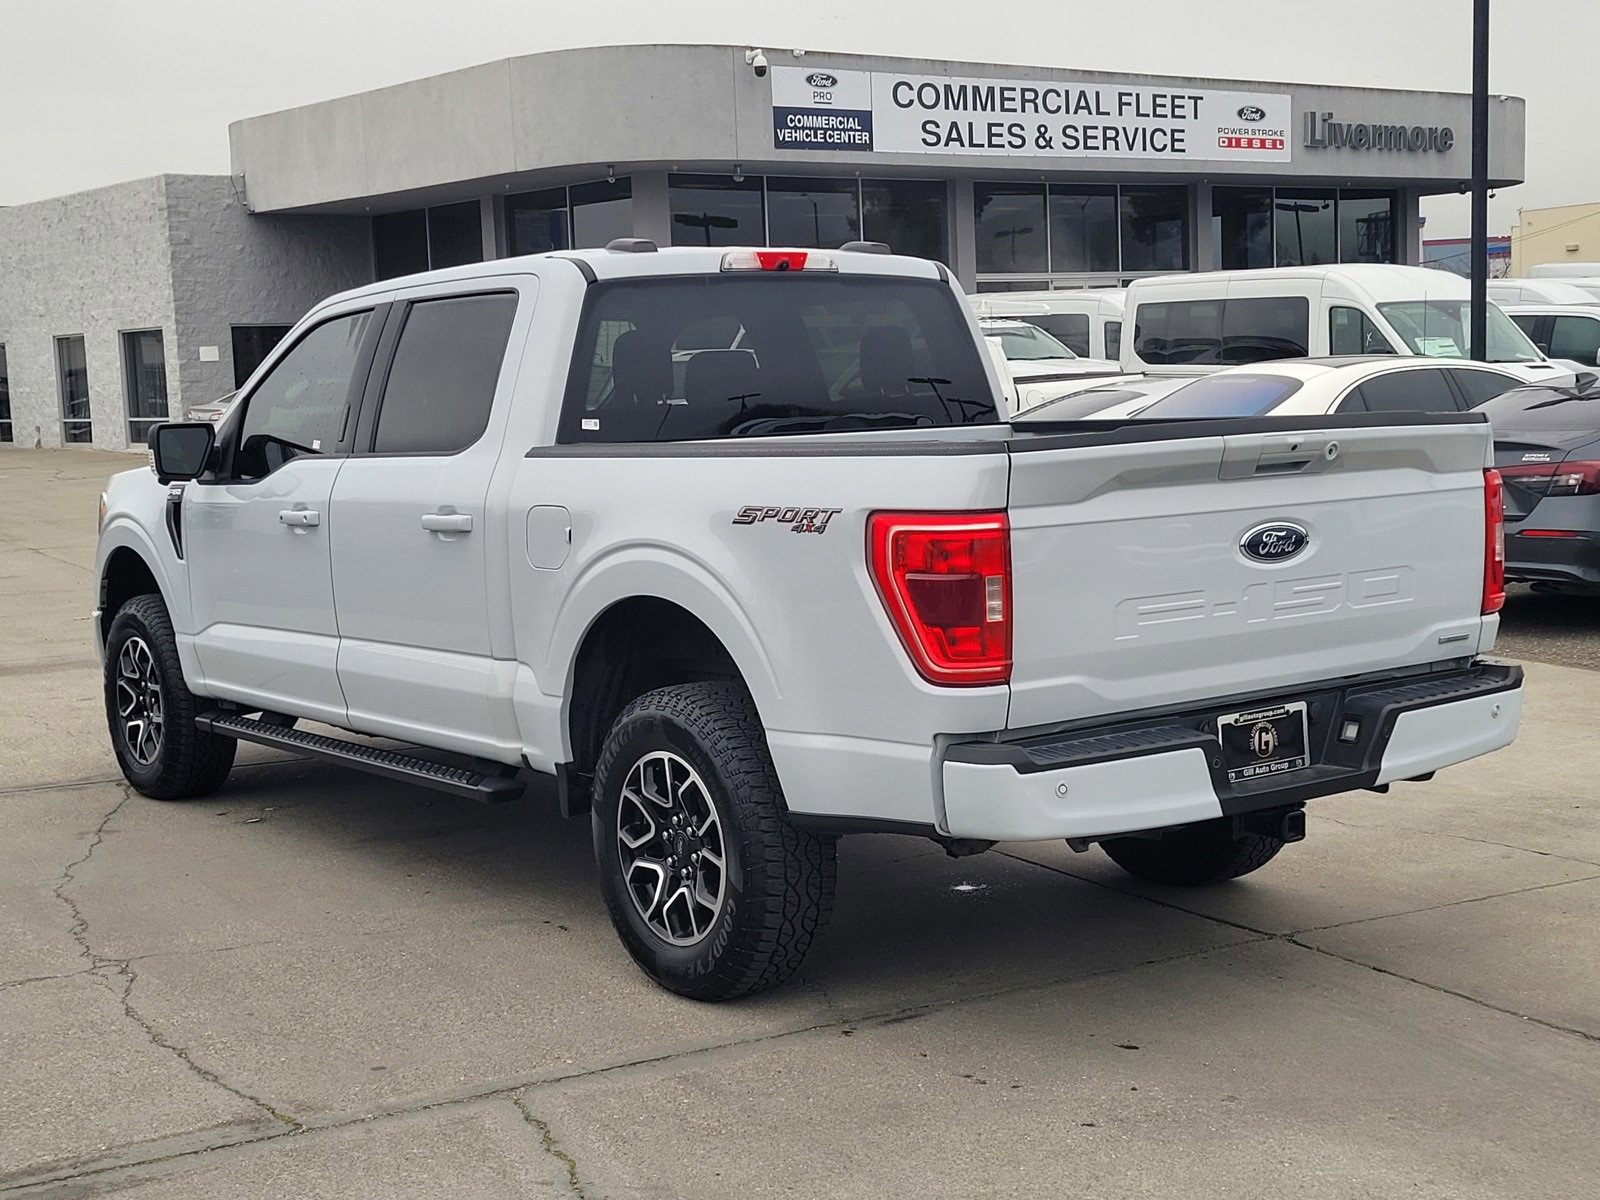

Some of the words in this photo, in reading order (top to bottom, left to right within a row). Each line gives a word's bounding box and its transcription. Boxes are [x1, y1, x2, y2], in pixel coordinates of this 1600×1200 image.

[810, 73, 833, 87] Ford
[812, 91, 833, 101] PRO
[891, 80, 1111, 117] COMMERCIAL
[1117, 91, 1204, 120] FLEET
[1241, 107, 1262, 120] Ford
[786, 114, 862, 130] COMMERCIAL
[776, 128, 825, 142] VEHICLE
[826, 130, 870, 144] CENTER
[920, 119, 1027, 149] SALES
[1034, 123, 1055, 150] &
[1061, 124, 1186, 153] SERVICE
[1303, 111, 1454, 152] Livermore
[1219, 137, 1284, 149] DIESEL
[731, 505, 843, 525] SPORT
[1258, 530, 1297, 555] Ford
[1113, 564, 1416, 641] F-150
[1255, 765, 1270, 775] Auto
[1270, 762, 1289, 771] Group
